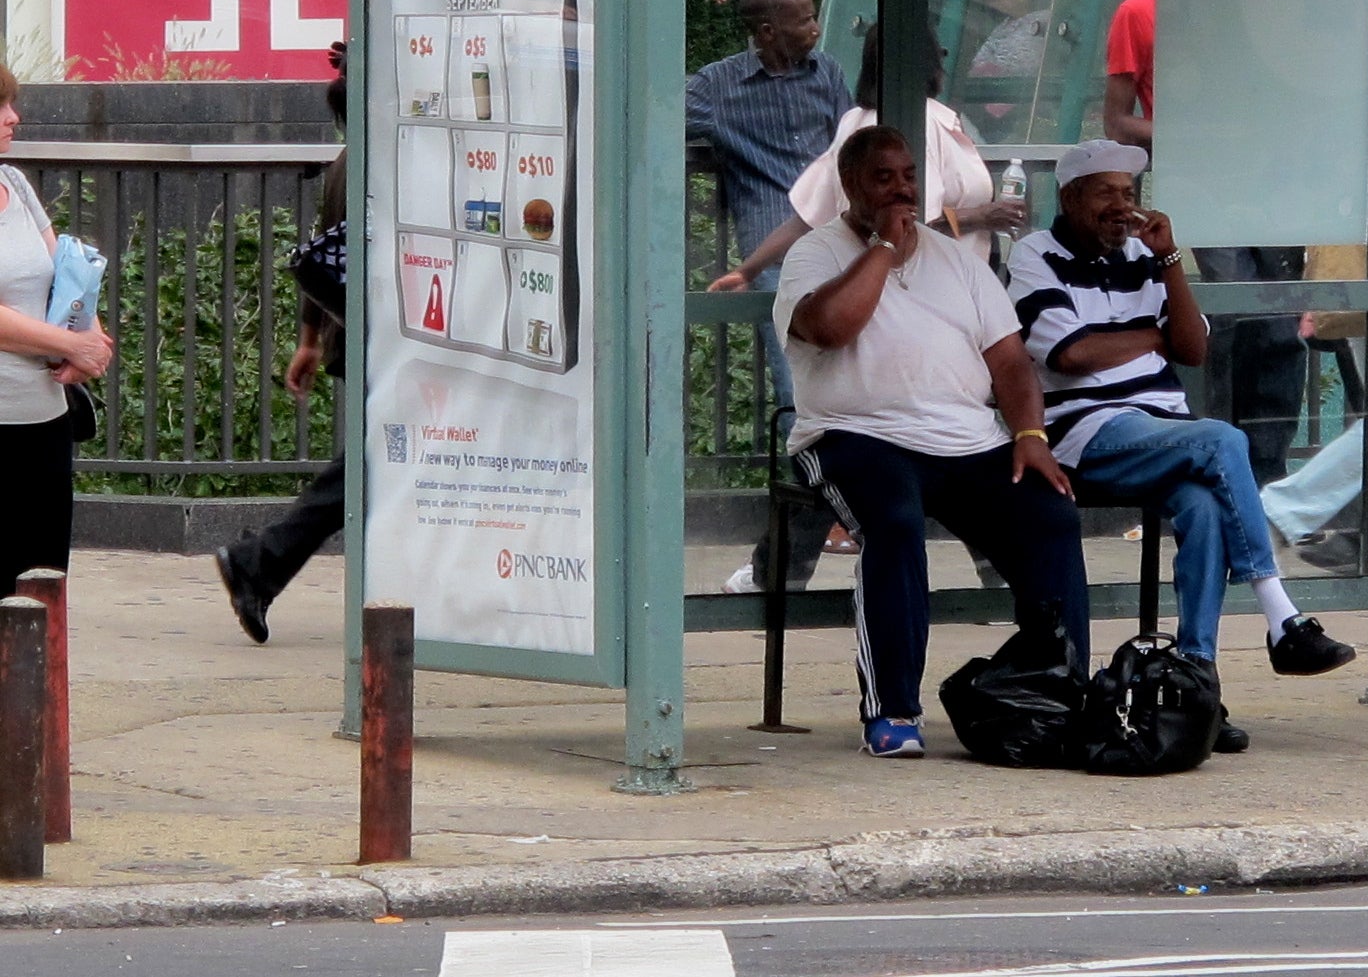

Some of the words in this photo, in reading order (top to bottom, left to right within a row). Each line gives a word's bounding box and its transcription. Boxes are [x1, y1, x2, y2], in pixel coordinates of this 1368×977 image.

[419, 34, 434, 58] $4
[472, 34, 486, 59] $5
[476, 148, 497, 173] $80
[528, 152, 554, 178] $10
[404, 253, 433, 268] DANGER
[443, 454, 461, 470] way
[463, 452, 475, 466] to
[477, 455, 508, 474] manage
[510, 457, 530, 474] your
[531, 458, 558, 475] money
[559, 457, 588, 475] online
[513, 553, 545, 579] PNC
[545, 555, 588, 582] BANK
